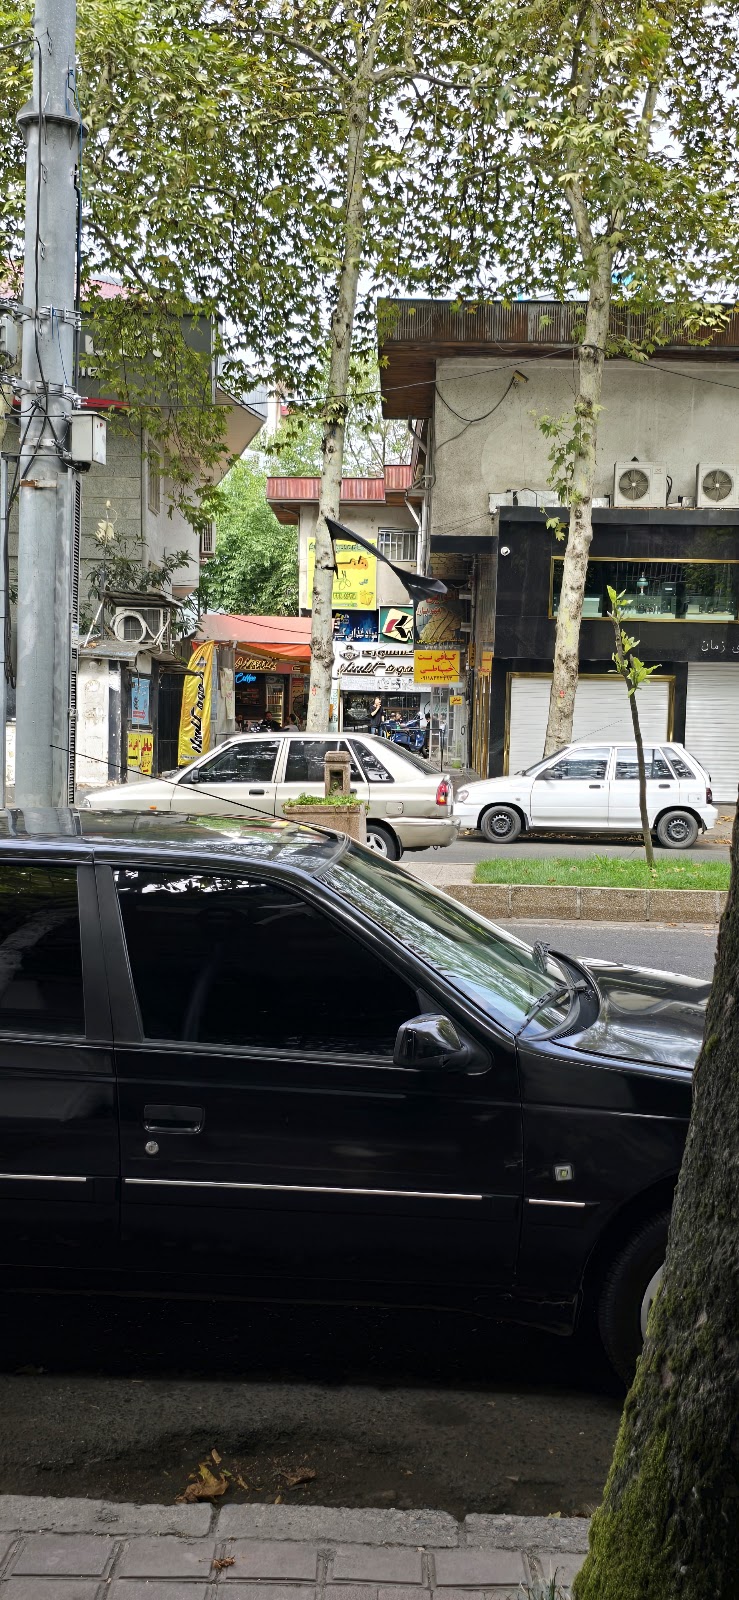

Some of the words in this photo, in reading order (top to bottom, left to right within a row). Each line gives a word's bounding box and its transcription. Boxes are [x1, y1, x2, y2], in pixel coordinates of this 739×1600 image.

[701, 640, 725, 653] زمان
[418, 653, 433, 661] نت
[434, 652, 456, 663] کافی
